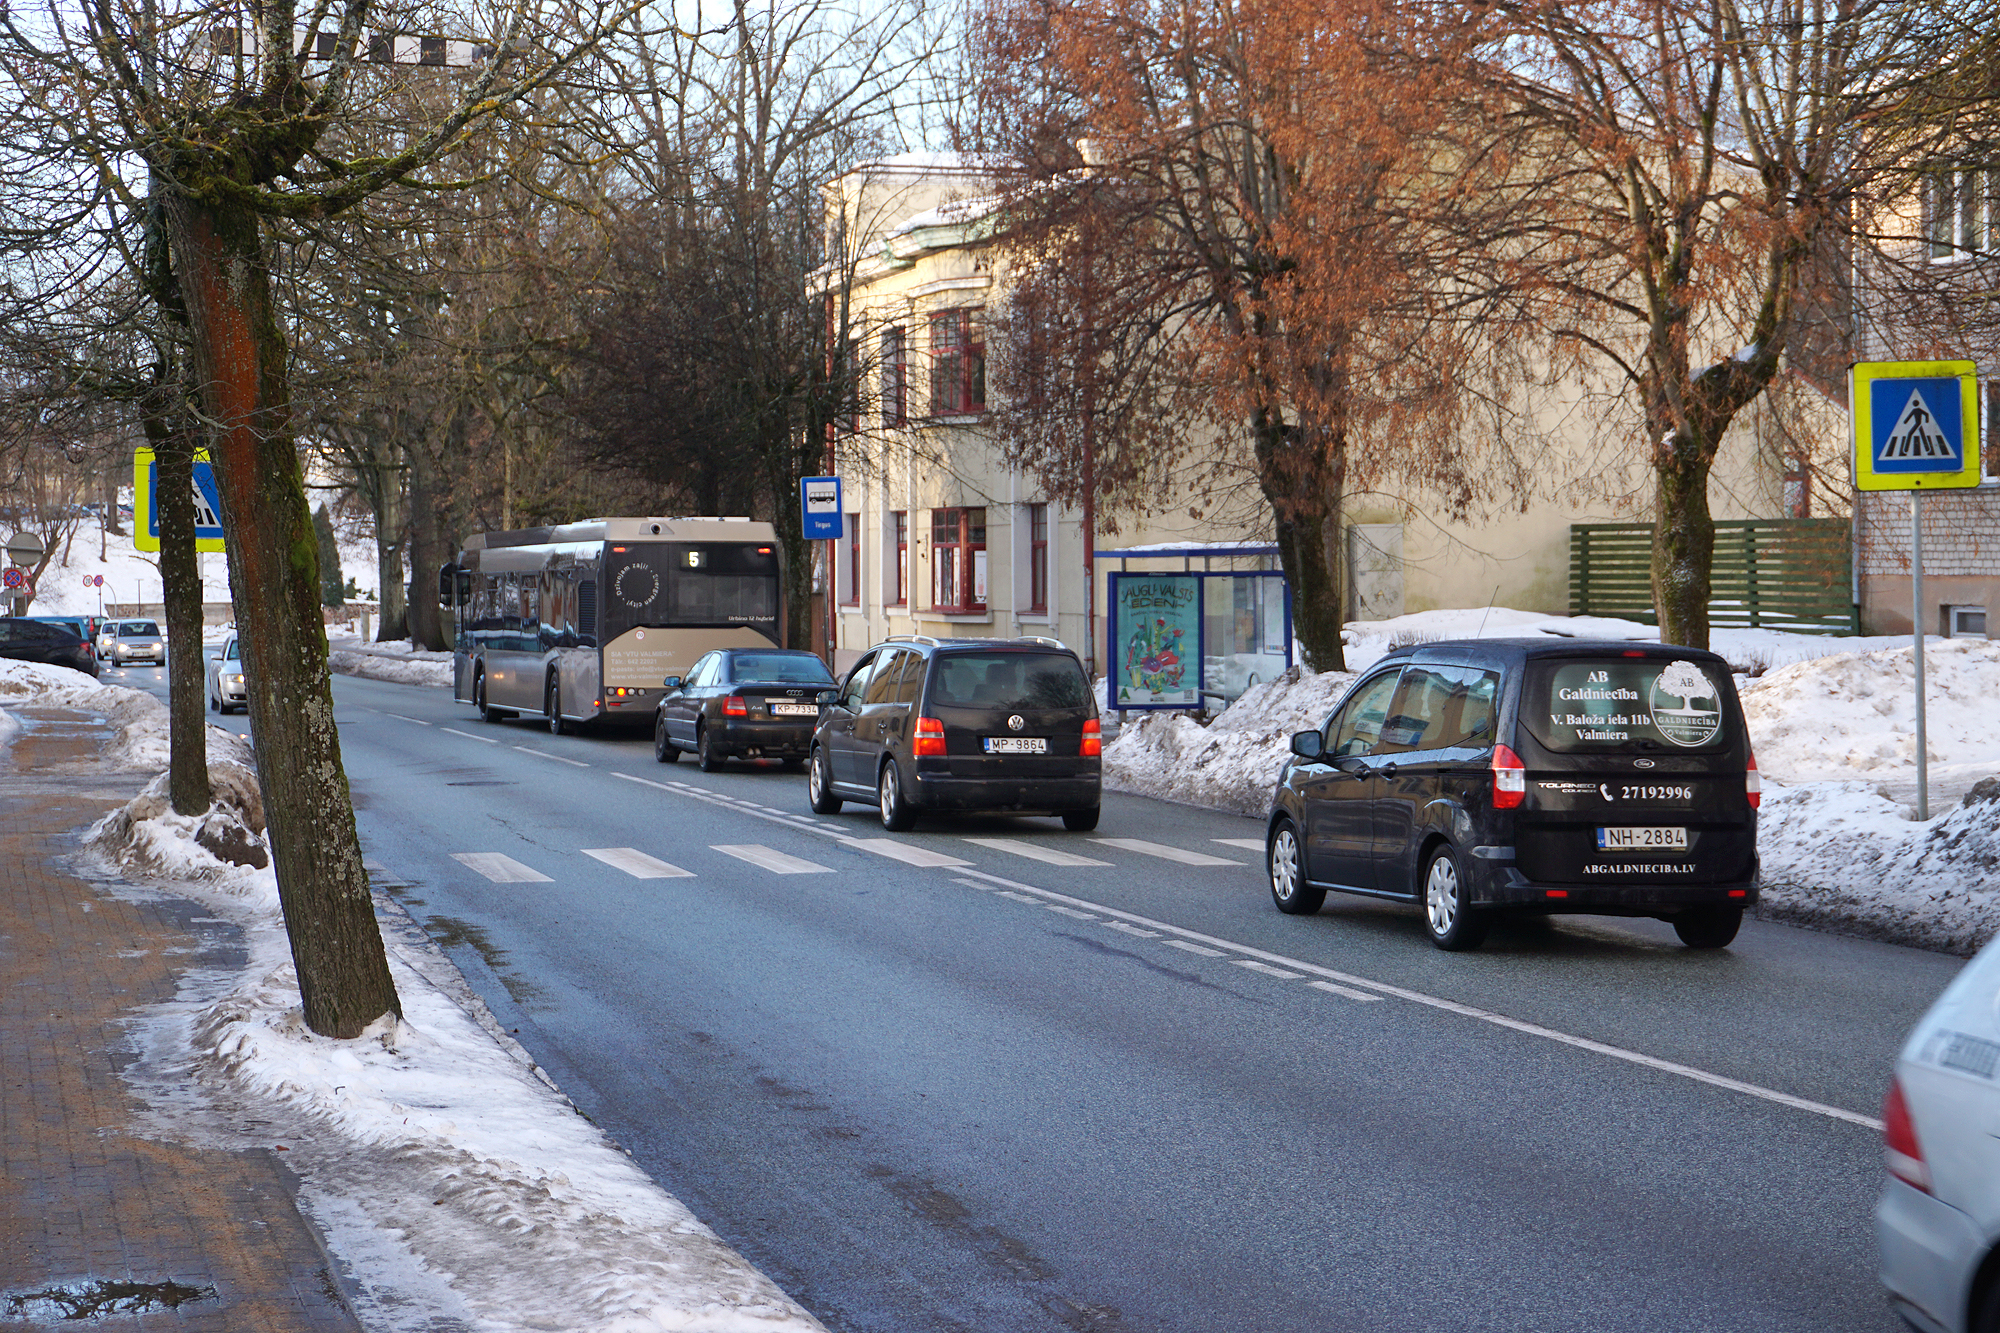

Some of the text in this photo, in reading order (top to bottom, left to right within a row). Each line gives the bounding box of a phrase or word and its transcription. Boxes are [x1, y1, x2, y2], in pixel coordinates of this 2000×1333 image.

[688, 551, 699, 567] 5
[1587, 670, 1609, 683] AB
[1679, 677, 1695, 688] AB
[1559, 687, 1639, 700] Galdniecība
[1550, 713, 1650, 725] V. Baloža iela 11b
[1576, 729, 1628, 740] Valmiera
[992, 739, 1044, 749] MP-9864
[1621, 786, 1692, 799] 27192996
[1609, 829, 1684, 845] NH-2884
[1582, 864, 1697, 874] ABGALDNIECIBA.LV
